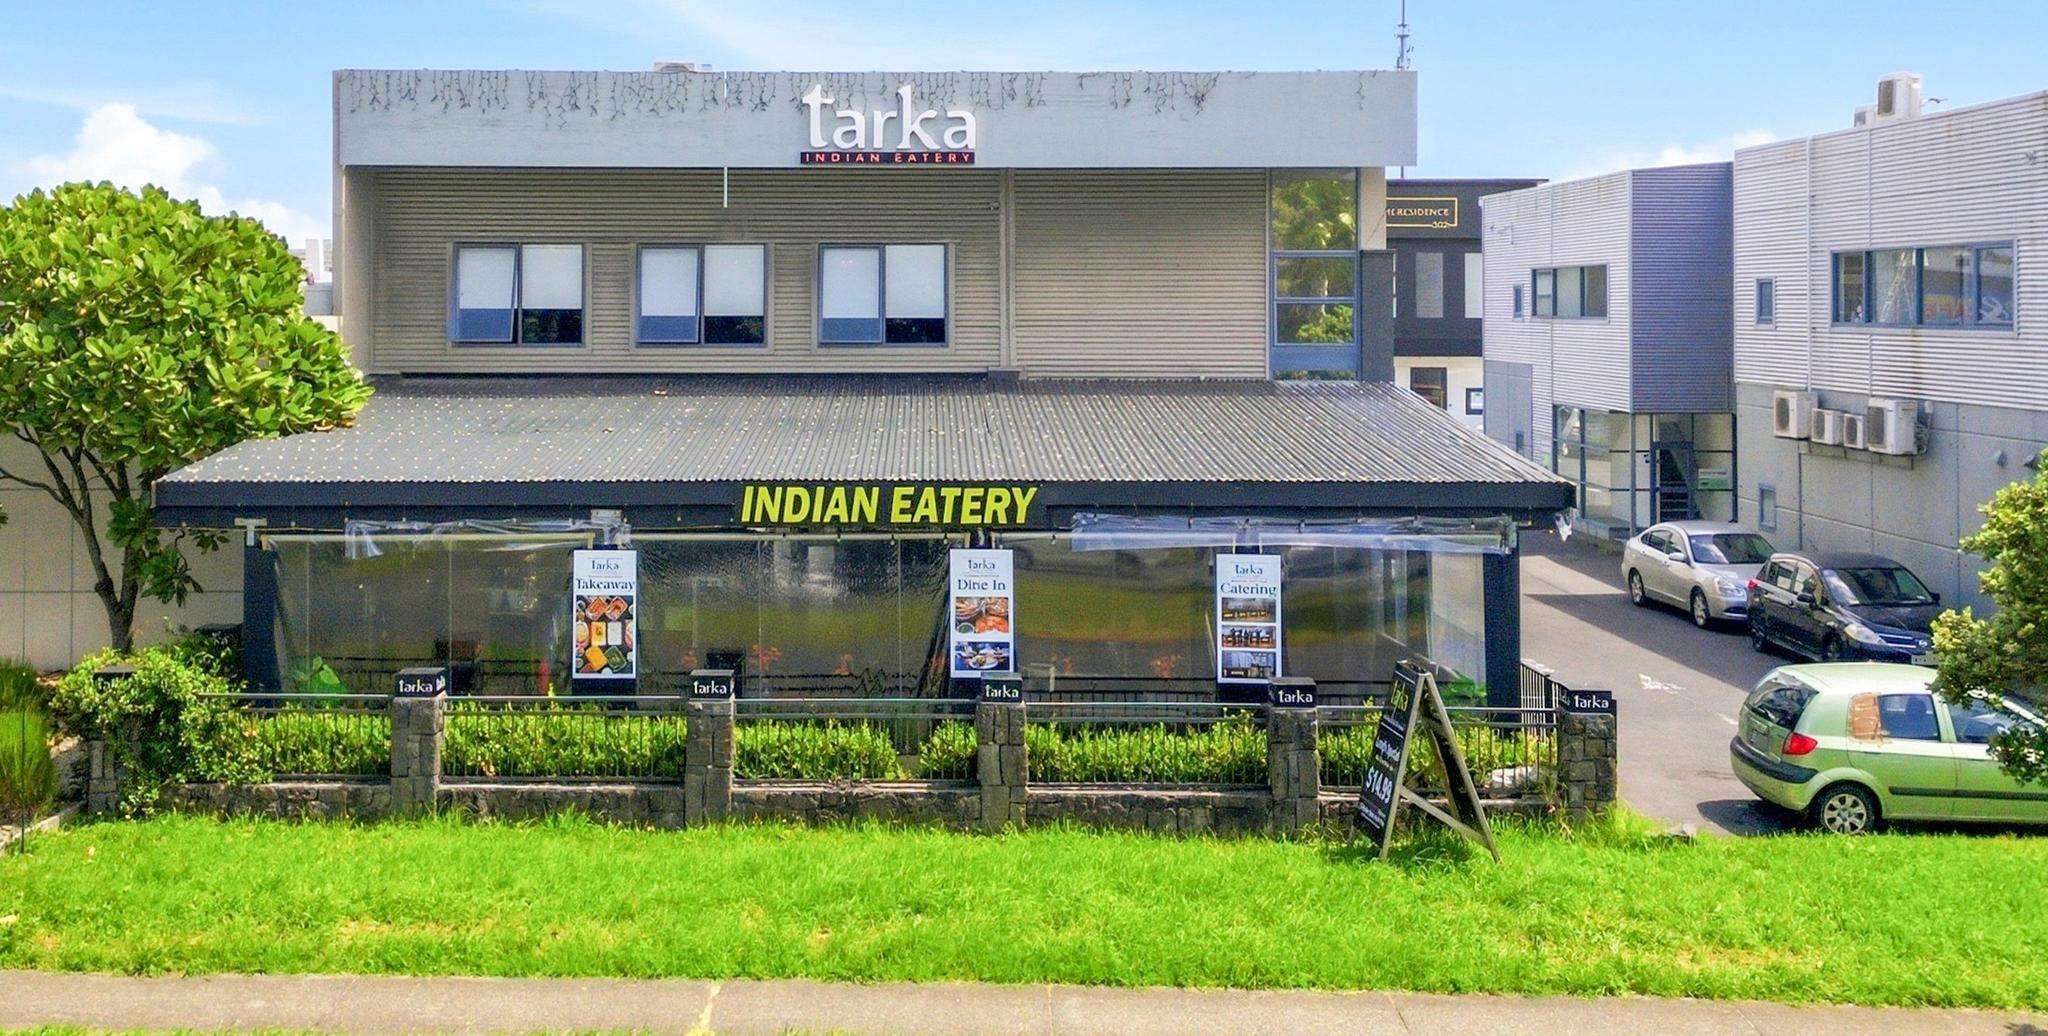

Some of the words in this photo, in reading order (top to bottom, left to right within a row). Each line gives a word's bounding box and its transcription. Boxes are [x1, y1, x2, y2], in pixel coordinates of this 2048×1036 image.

[802, 84, 976, 150] tarka
[805, 153, 880, 163] INDIAN
[894, 153, 971, 163] EATERY
[1396, 207, 1449, 217] RESIDENCE
[741, 486, 879, 523] INDIAN
[890, 486, 1037, 524] EATERY
[591, 559, 619, 570] tarka
[967, 558, 996, 569] tarka
[1235, 564, 1264, 575] tarka
[576, 578, 635, 591] Takeaway
[957, 579, 989, 590] Dine
[993, 579, 1007, 590] In
[1220, 582, 1277, 598] Catering
[399, 679, 434, 693] tarka
[693, 680, 728, 694] tarka
[985, 684, 1020, 698] tarka
[1278, 689, 1314, 703] tarka
[1573, 694, 1610, 708] tarka
